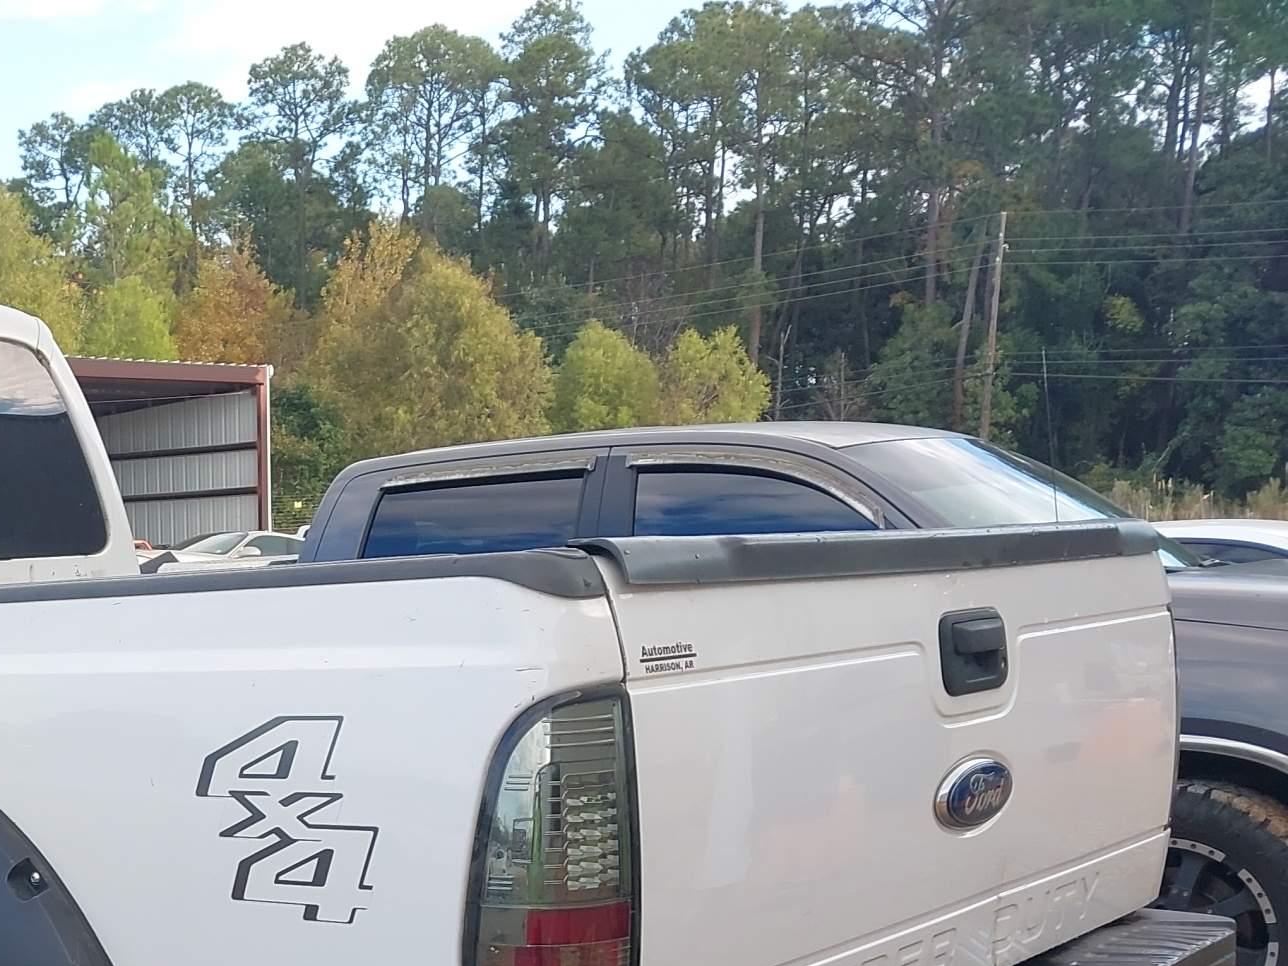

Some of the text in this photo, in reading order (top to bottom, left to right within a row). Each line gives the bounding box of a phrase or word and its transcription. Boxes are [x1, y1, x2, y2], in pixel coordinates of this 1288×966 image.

[641, 642, 693, 657] Automotive
[645, 660, 694, 673] HARRISON, AR
[964, 771, 1005, 816] Ford
[989, 871, 1101, 957] DUTY
